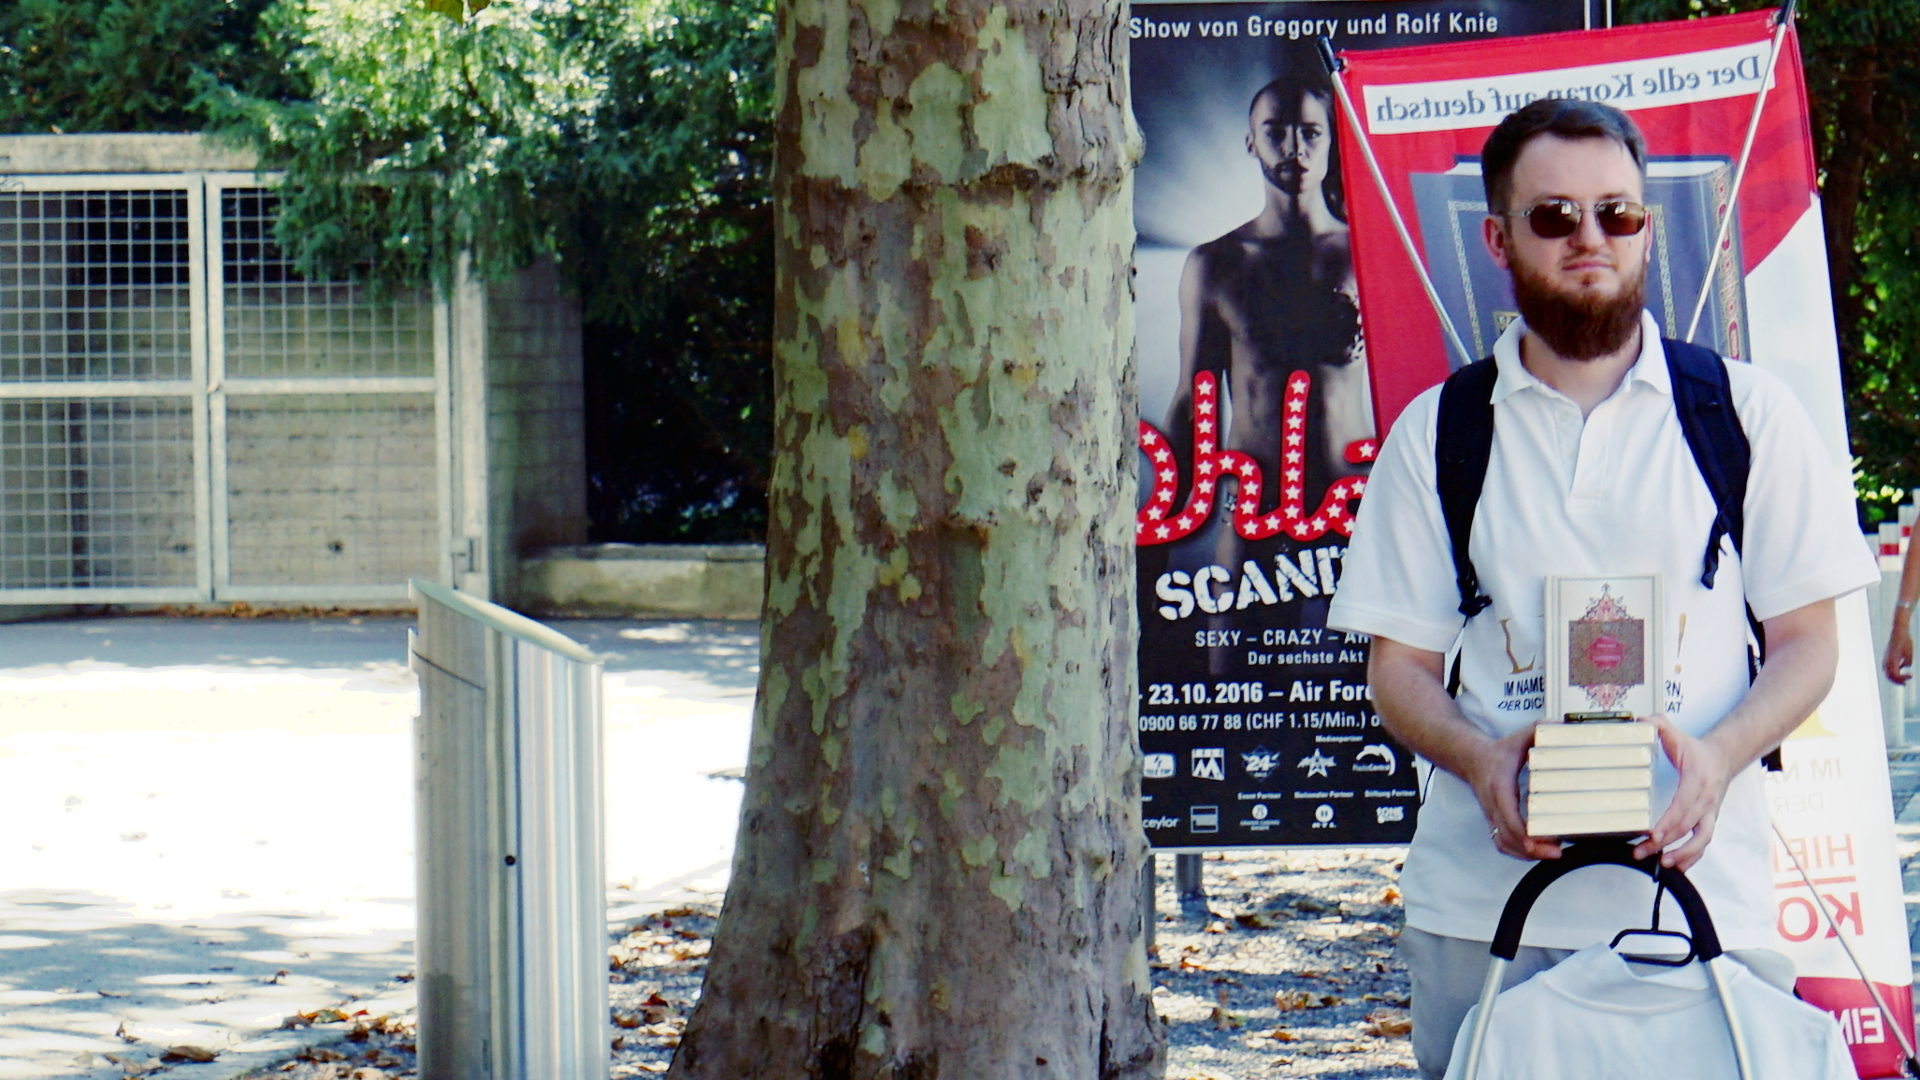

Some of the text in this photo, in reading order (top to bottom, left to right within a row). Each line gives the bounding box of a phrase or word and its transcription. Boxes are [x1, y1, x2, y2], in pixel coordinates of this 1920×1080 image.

[1128, 12, 1499, 40] Show von Gregory und Rolf Knie
[1195, 630, 1241, 647] SEXY
[1263, 629, 1322, 646] CRAZY
[1248, 648, 1364, 665] Der sechste Akt
[1289, 680, 1323, 703] Air
[1139, 715, 1174, 732] 0900
[1179, 714, 1198, 731] 66
[1202, 713, 1218, 731] 77
[1223, 713, 1242, 730] 88
[1246, 711, 1284, 731] (CHF
[1289, 710, 1366, 729] 1.15/Min.)
